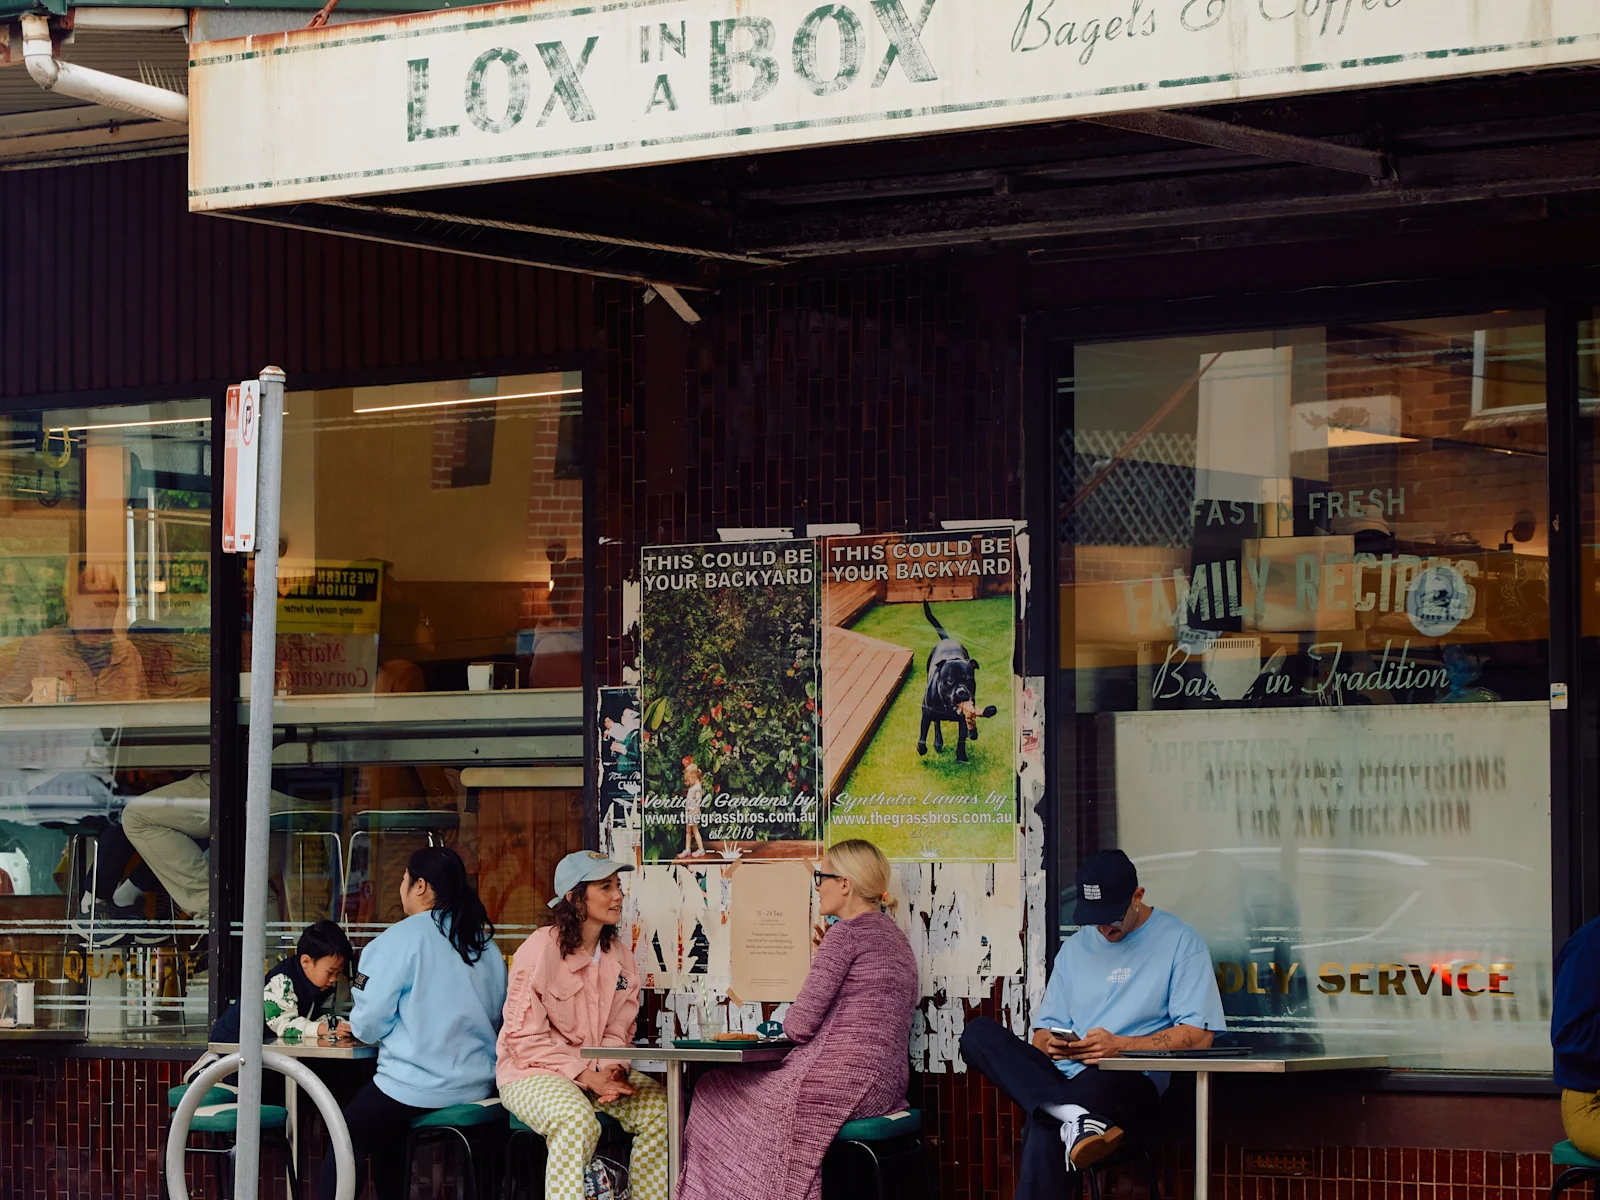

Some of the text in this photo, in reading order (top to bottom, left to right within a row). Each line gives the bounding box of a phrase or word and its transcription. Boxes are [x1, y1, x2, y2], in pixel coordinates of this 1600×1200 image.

[1011, 0, 1156, 65] Bagels
[406, 0, 938, 143] LOX IN A BOX
[1189, 498, 1265, 527] FAST
[1308, 487, 1406, 521] FRESH
[644, 548, 813, 572] THIS COULD BE
[831, 538, 1011, 562] THIS COULD BE
[644, 567, 813, 591] YOUR BACKYARD
[831, 557, 1011, 583] YOUR BACKYARD
[1123, 556, 1271, 634] FAMILY
[1265, 667, 1293, 694] in
[1301, 638, 1449, 694] Tradition
[714, 793, 789, 807] Gardens
[792, 790, 817, 812] by
[832, 790, 1008, 814] Synthetic Lawns by
[645, 809, 816, 827] www.thegrassbros.com.au
[832, 811, 1012, 828] www.thegrassbros.com.au
[1316, 962, 1515, 997] SERVICE
